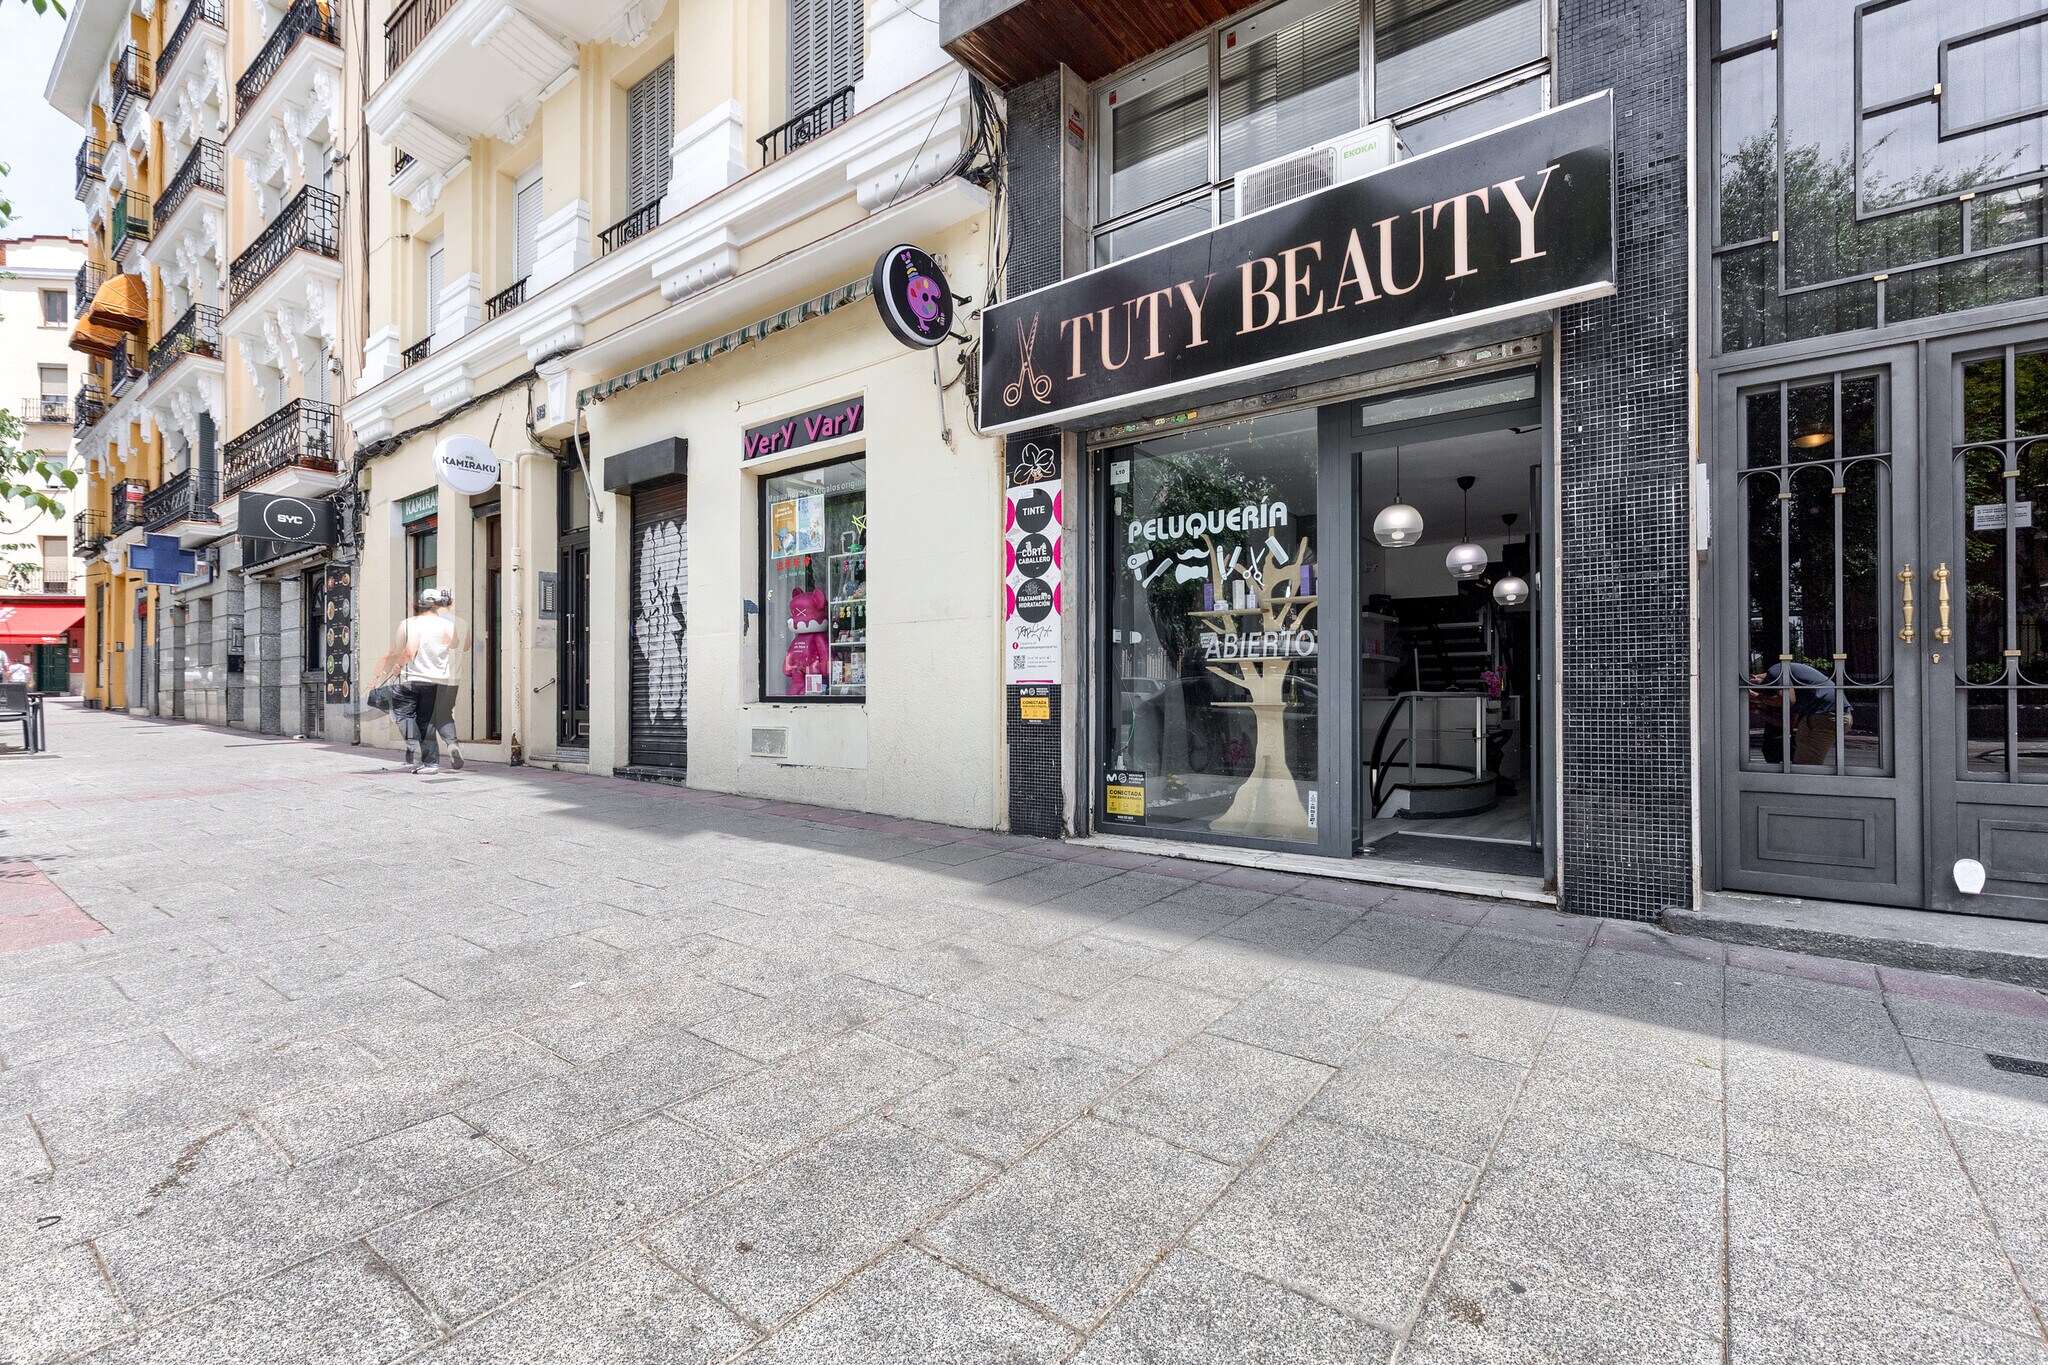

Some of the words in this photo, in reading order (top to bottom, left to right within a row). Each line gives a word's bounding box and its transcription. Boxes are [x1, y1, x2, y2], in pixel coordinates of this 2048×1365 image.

[1343, 141, 1377, 159] EKOKAI
[1060, 272, 1217, 380] TUTY
[1236, 164, 1560, 335] BEAUTY
[442, 456, 496, 473] KAMIRAKU
[1022, 505, 1046, 516] TINTE
[277, 514, 303, 525] SYC
[1128, 496, 1288, 544] PELUQUERÍA
[1021, 547, 1047, 557] CORTE
[1018, 556, 1051, 565] CABALLERO
[1205, 629, 1315, 659] ABIERTO
[1109, 789, 1142, 797] CONECTADA
